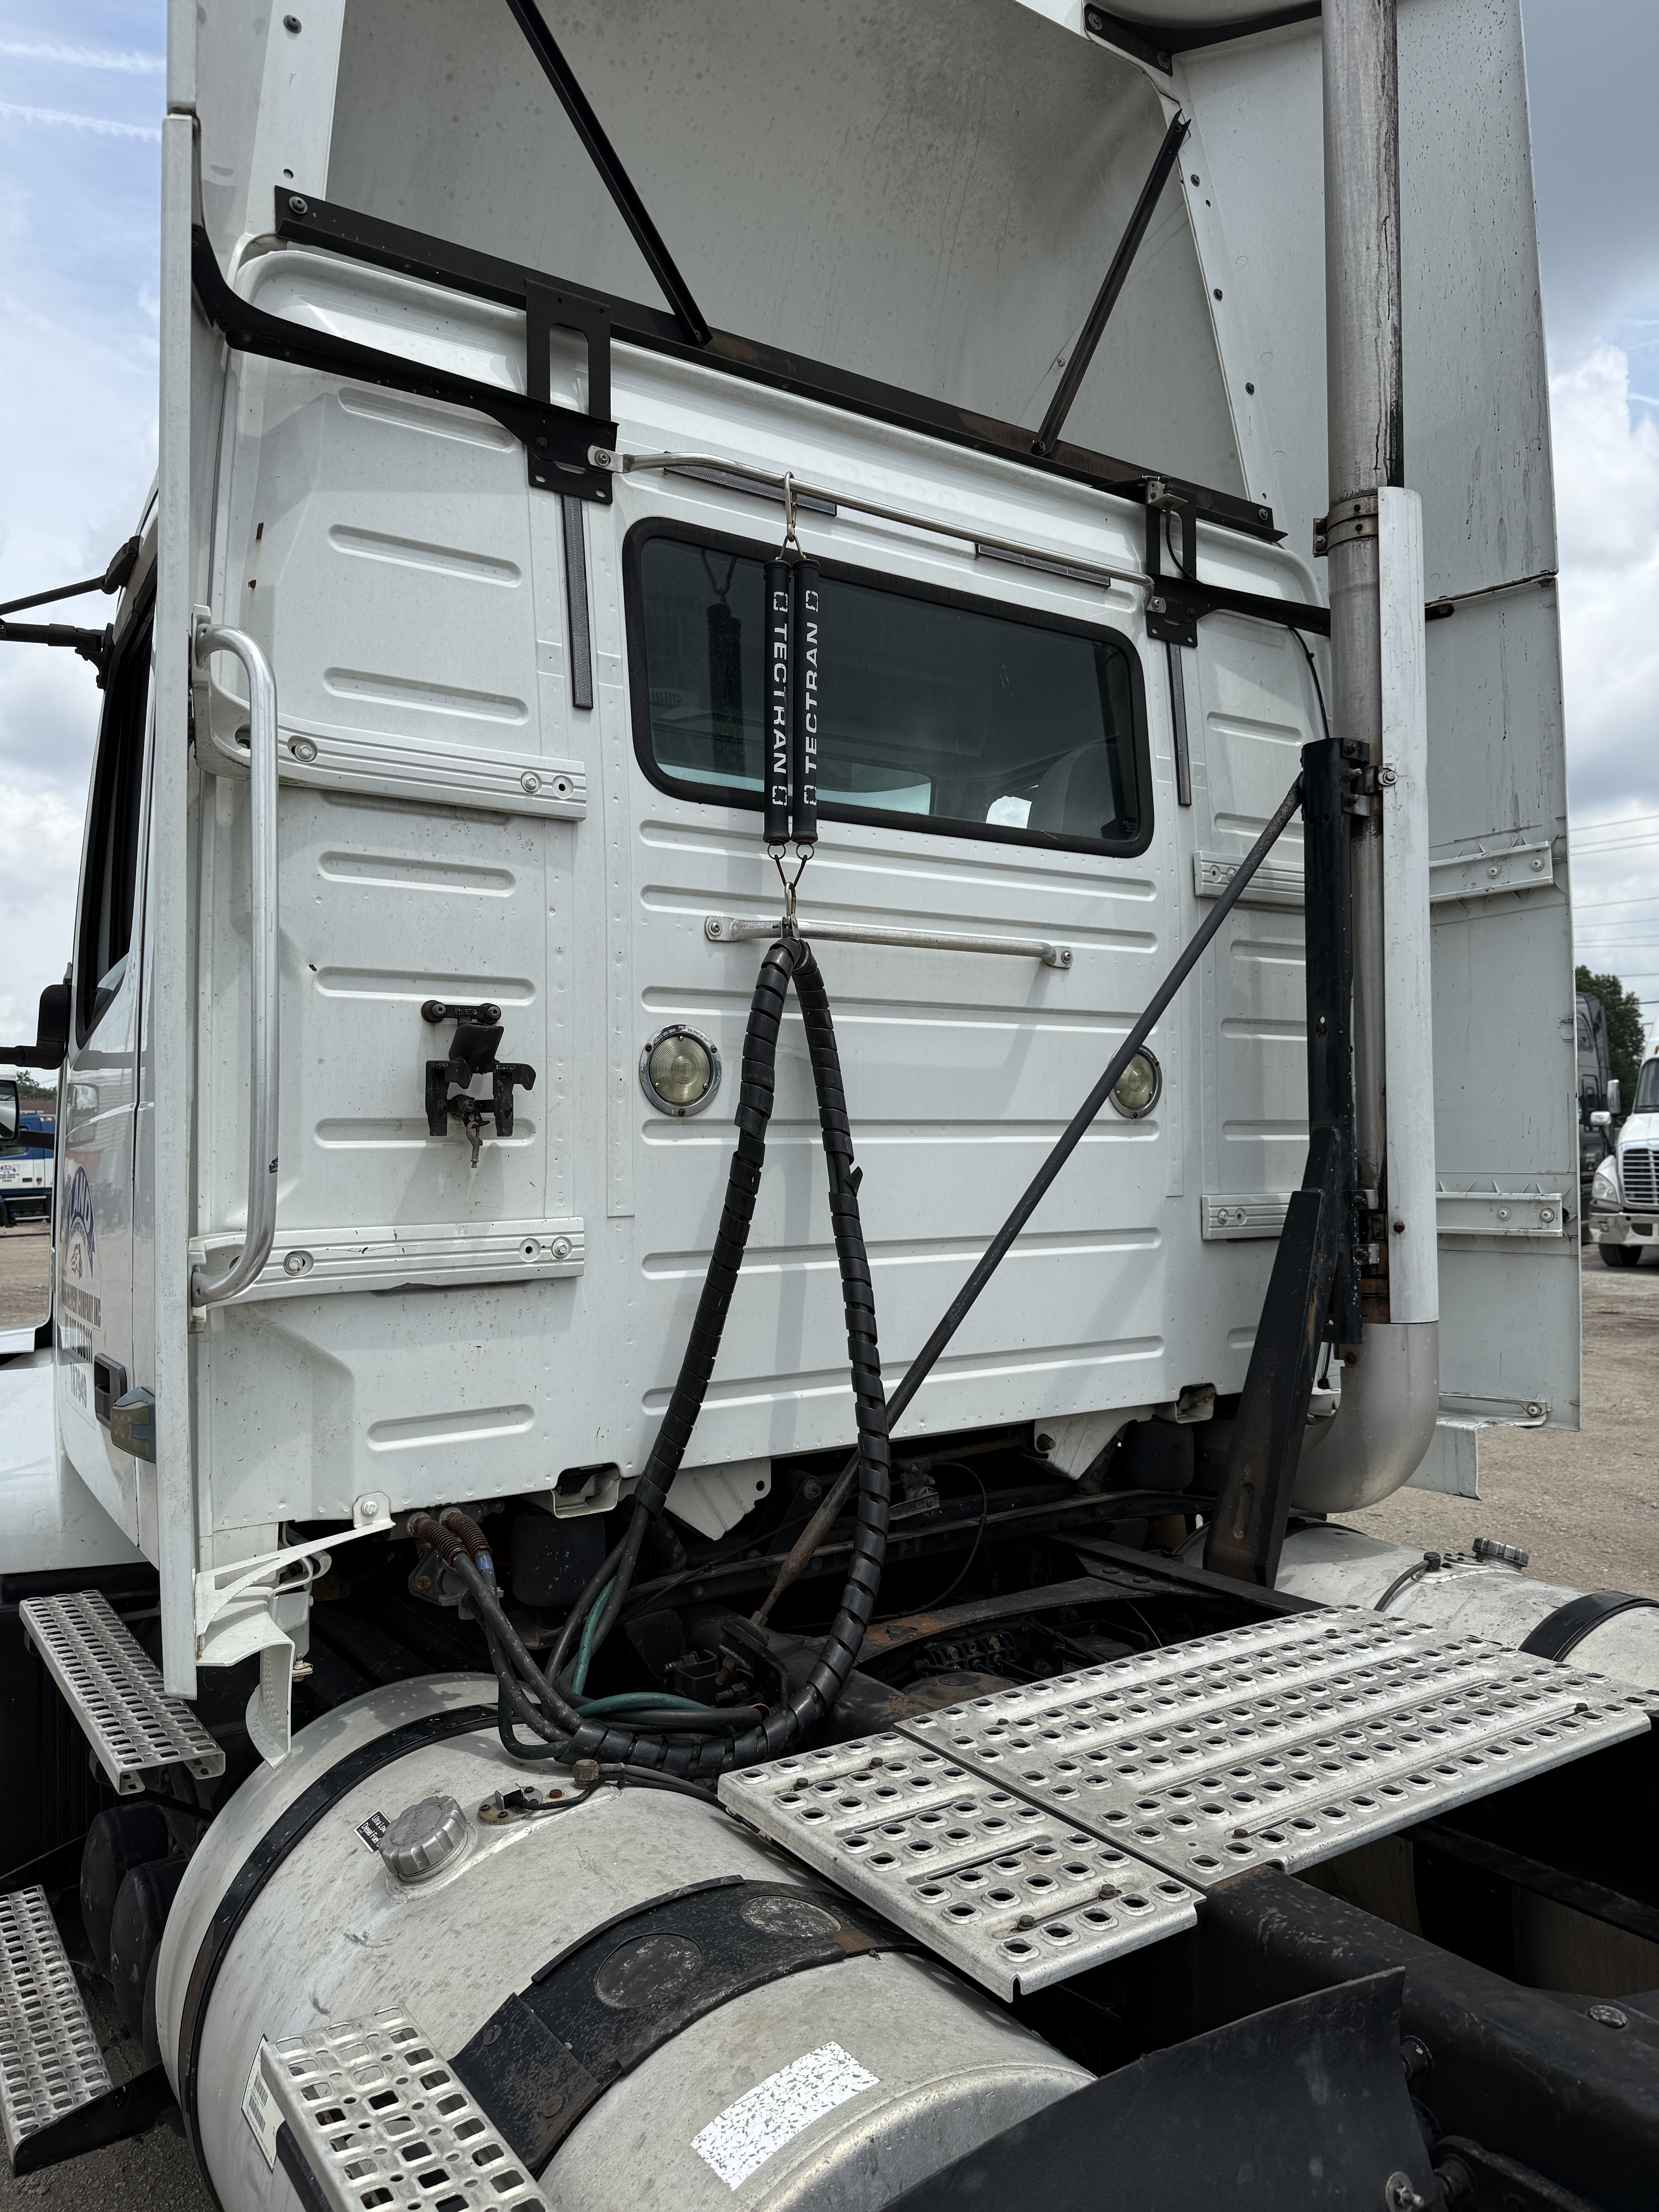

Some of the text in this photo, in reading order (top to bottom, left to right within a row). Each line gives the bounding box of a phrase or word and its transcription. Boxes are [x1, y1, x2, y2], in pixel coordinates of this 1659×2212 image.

[773, 623, 787, 774] TECTRAN
[805, 622, 819, 774] TECTRAN
[69, 1171, 92, 1234] LAND
[70, 1362, 87, 1409] 187949
[361, 1822, 381, 1844] Diesel Fuel
[371, 1814, 381, 1826] Ultra
